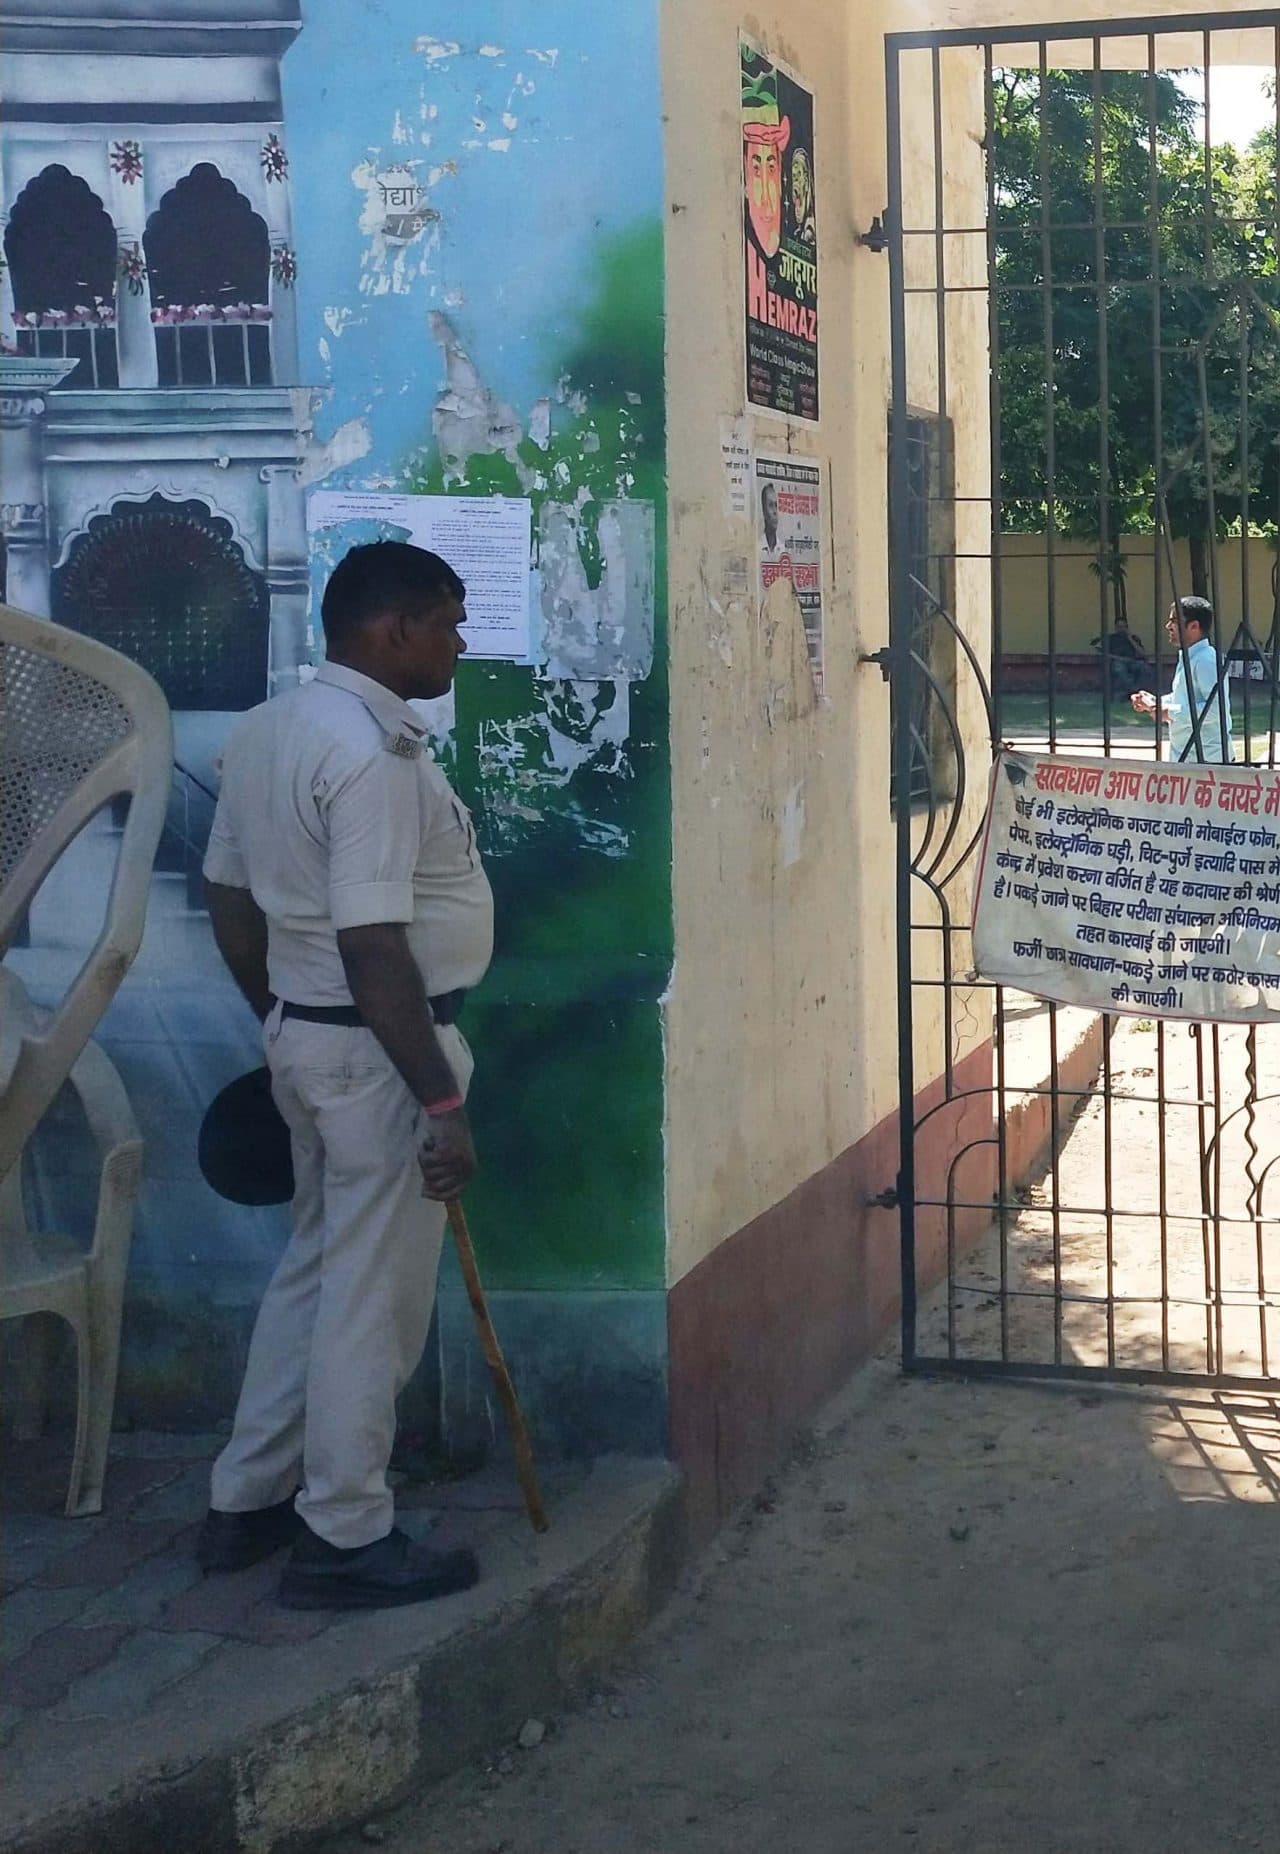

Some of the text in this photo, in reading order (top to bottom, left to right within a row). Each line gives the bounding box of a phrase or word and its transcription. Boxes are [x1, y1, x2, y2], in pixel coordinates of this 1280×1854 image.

[747, 239, 817, 343] HEMRAZ
[779, 248, 816, 300] जादूगर
[1035, 763, 1104, 797] सावधान
[1104, 771, 1143, 801] आप
[1146, 774, 1191, 806] CCTV
[1194, 770, 1216, 808] के
[1218, 774, 1263, 815] दायरे
[1015, 795, 1036, 819] कोई
[1036, 800, 1054, 820] भी
[1127, 816, 1162, 836] गजट
[1164, 817, 1193, 839] यानी
[1196, 819, 1247, 846] मोबाईल
[1249, 826, 1280, 850] फोन,
[1009, 820, 1033, 846] पेपर,
[1107, 838, 1134, 865] घड़ी,
[1194, 851, 1237, 873] इत्यादि
[1239, 858, 1265, 876] पास
[1025, 853, 1038, 874] में
[1037, 856, 1064, 879] प्रवेश
[1066, 865, 1103, 886] करना
[1105, 866, 1143, 891] वर्जित
[1144, 871, 1157, 894] है
[1158, 877, 1179, 898] यह
[1182, 881, 1231, 901] कदाचार
[1233, 881, 1253, 901] की
[1014, 883, 1040, 908] पकड़े
[1041, 887, 1070, 908] जाने
[1072, 894, 1088, 912] पर
[1089, 892, 1125, 918] बिहार
[1126, 898, 1163, 923] परीक्षा
[1165, 904, 1216, 927] संचालन
[1013, 938, 1043, 960] फर्जी
[1158, 960, 1189, 981] जाने
[1191, 966, 1210, 983] पर
[1212, 963, 1247, 986] कठोर
[1075, 923, 1106, 944] तहत
[1157, 931, 1177, 953] की
[1180, 933, 1230, 955] जाएगी।
[1111, 982, 1183, 1008] की जाएगी।
